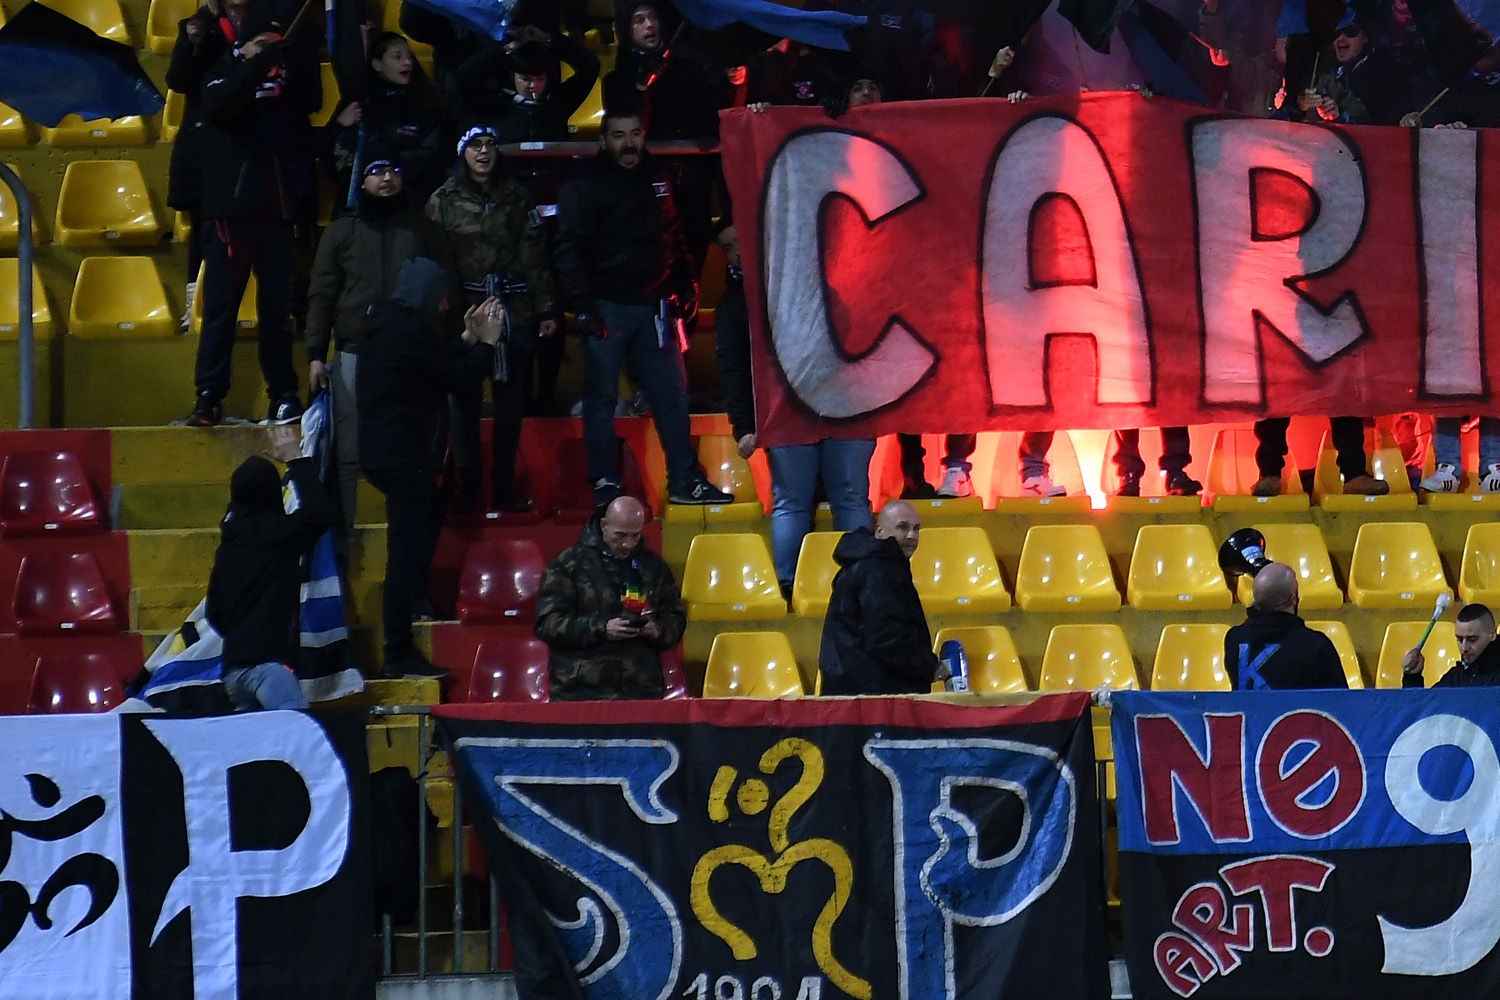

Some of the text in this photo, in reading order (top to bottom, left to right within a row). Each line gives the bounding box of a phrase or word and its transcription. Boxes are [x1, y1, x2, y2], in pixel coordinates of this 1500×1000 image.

[1238, 643, 1283, 691] K
[140, 709, 352, 1000] P
[862, 738, 1076, 1000] P
[1153, 853, 1336, 998] ART.
